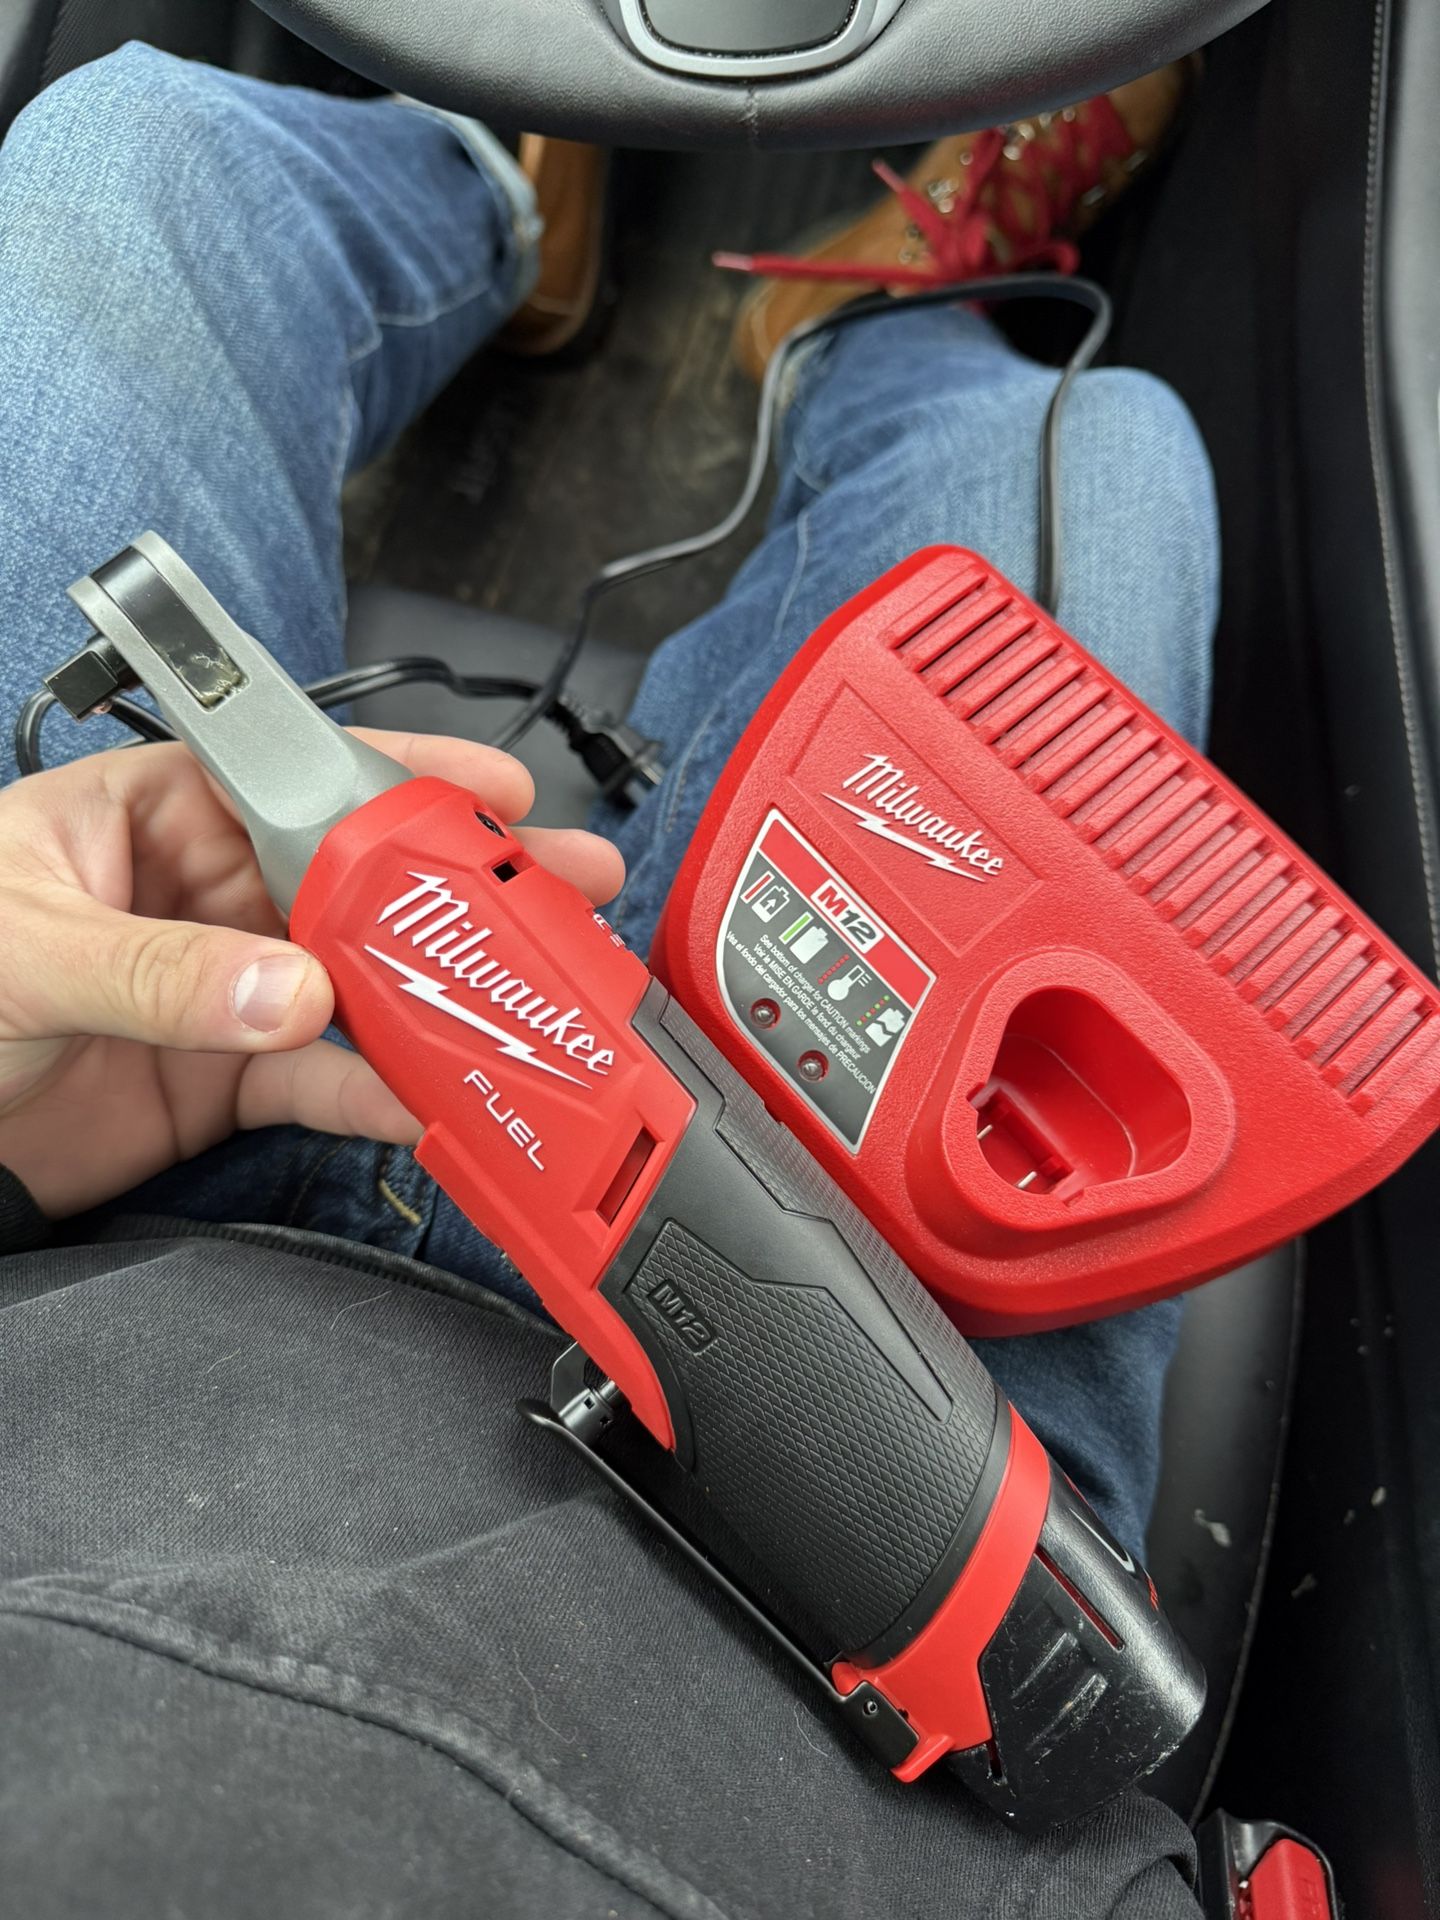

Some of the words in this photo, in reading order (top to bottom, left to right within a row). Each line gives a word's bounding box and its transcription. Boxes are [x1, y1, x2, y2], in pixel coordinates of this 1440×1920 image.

[843, 754, 1003, 876] Milwaukee
[818, 885, 877, 945] M12
[376, 871, 615, 1076] Milwaukee
[727, 931, 738, 946] Vea
[741, 948, 757, 966] fondo
[763, 973, 787, 998] cargador
[783, 997, 799, 1012] para
[804, 1018, 831, 1046] mensajes
[753, 943, 766, 957] Voir
[768, 960, 786, 979] MISE
[791, 985, 815, 1009] GARDE
[816, 1012, 832, 1028] fond
[835, 1034, 861, 1059] chargeur
[770, 945, 790, 967] bottom
[793, 971, 815, 993] charger
[820, 999, 849, 1028] CAUTION
[845, 1027, 870, 1053] markings
[463, 1069, 545, 1171] FUEL
[654, 1284, 711, 1345] M12
